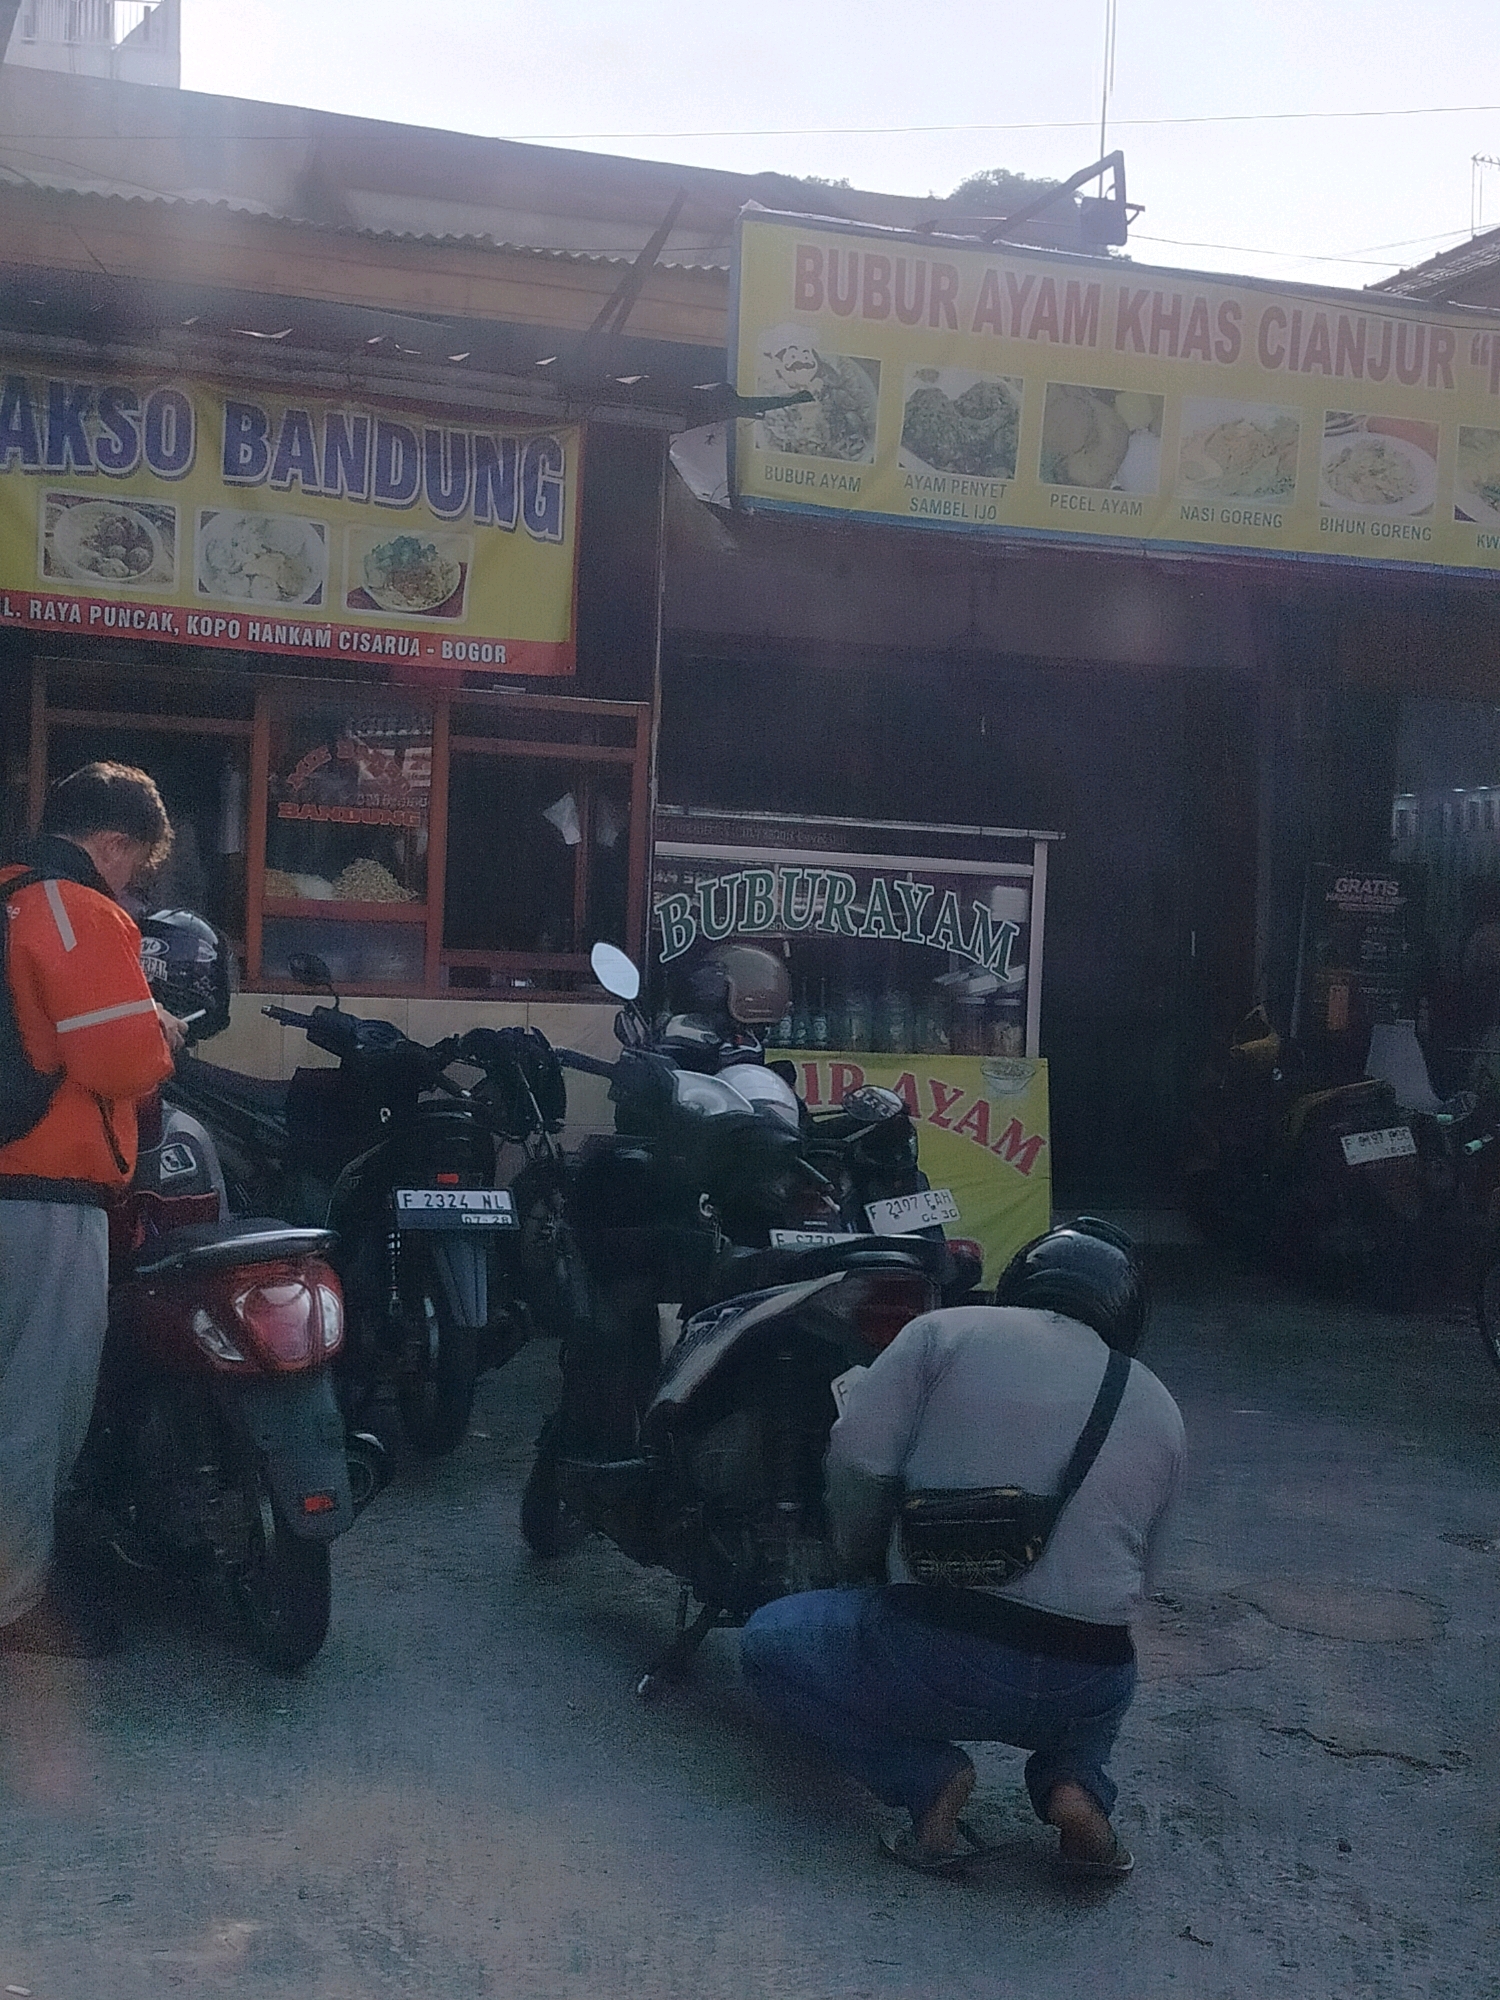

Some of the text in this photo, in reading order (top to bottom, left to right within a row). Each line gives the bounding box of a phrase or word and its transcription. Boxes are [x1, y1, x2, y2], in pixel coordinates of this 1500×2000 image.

[794, 244, 959, 331] BUBUR
[971, 269, 1101, 347] AYAM
[1115, 287, 1242, 364] KHAS
[1258, 306, 1455, 390] CIANJUR
[0, 373, 565, 544] AKSO BANDUNG
[765, 465, 861, 492] BUBUR AYAM
[904, 474, 1007, 499] AYAM PENYET
[910, 497, 997, 520] SAMBEL IJO
[1050, 494, 1142, 516] PECEL AYAM
[1180, 505, 1282, 528] NASI GORENG
[1320, 517, 1431, 541] BIHUN GORENG
[29, 599, 81, 623] RAYA
[89, 606, 179, 636] PUNCAK,
[187, 615, 240, 639] KOPO
[248, 621, 331, 648] HANKAM
[339, 631, 420, 657] CISARUA
[441, 640, 507, 664] BOGOR
[277, 801, 421, 828] BANDUNG
[1334, 877, 1400, 896] GRATIS
[403, 1194, 504, 1209] F 2324 NL
[869, 1205, 877, 1220] F
